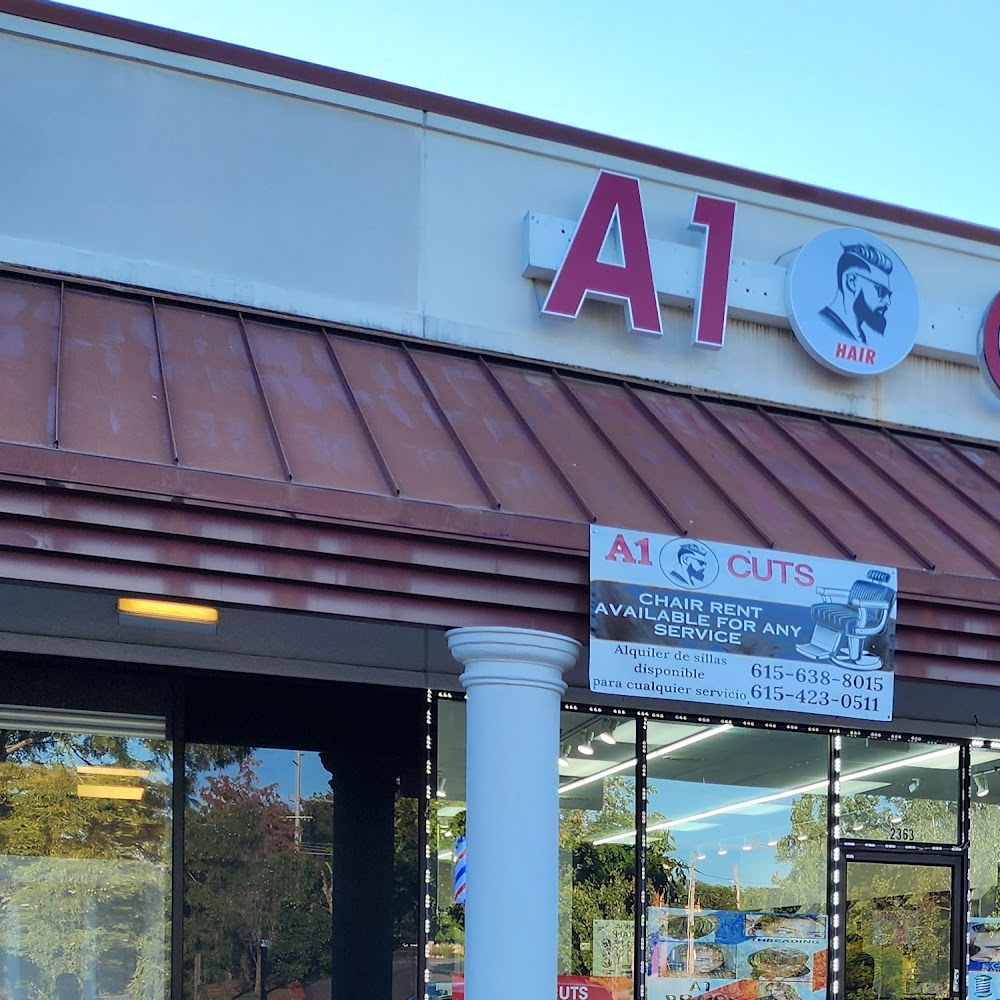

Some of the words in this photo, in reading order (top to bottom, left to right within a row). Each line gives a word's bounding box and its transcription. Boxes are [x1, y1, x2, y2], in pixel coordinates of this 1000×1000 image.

[540, 169, 738, 350] A1
[835, 342, 877, 366] HAIR
[604, 533, 653, 567] A1
[727, 554, 815, 588] CUTS
[638, 592, 704, 612] CHAIR
[709, 601, 763, 619] RENT
[594, 602, 710, 627] AVAILABLE
[716, 618, 756, 633] FOR
[762, 622, 802, 638] ANY
[653, 624, 742, 645] SERVICE
[614, 644, 670, 659] Alquiler
[674, 650, 690, 662] de
[693, 652, 728, 666] sillas
[634, 663, 705, 680] disponible
[750, 662, 884, 692] 615-638-8015
[592, 677, 623, 690] para
[626, 681, 692, 696] cualquier
[695, 686, 747, 701] servicio
[750, 684, 880, 712] 615-423-0511
[889, 827, 915, 841] 2363
[557, 985, 589, 1000] UTS
